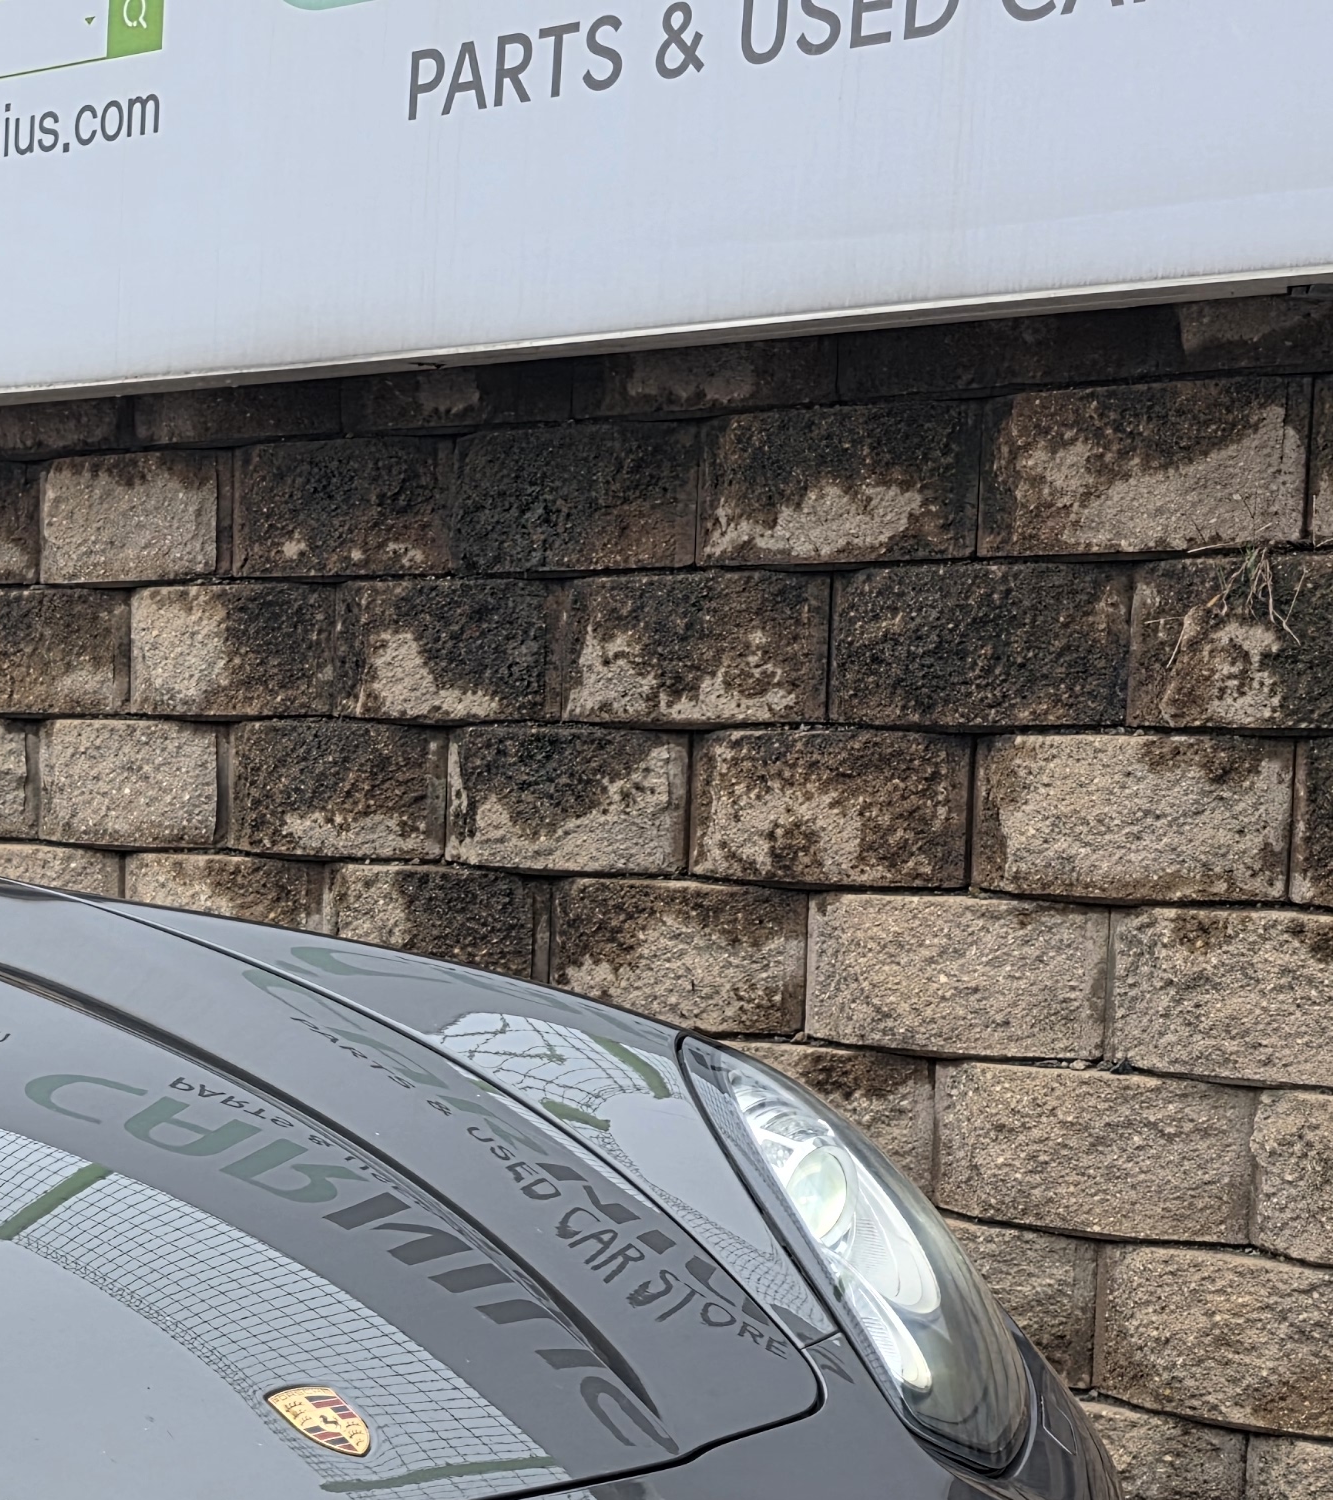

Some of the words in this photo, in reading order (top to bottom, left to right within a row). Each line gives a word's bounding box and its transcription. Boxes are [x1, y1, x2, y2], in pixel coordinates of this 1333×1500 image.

[407, 14, 624, 121] PARTS
[654, 1, 705, 80] &
[465, 1126, 562, 1201] USED
[555, 1206, 645, 1284] CAR
